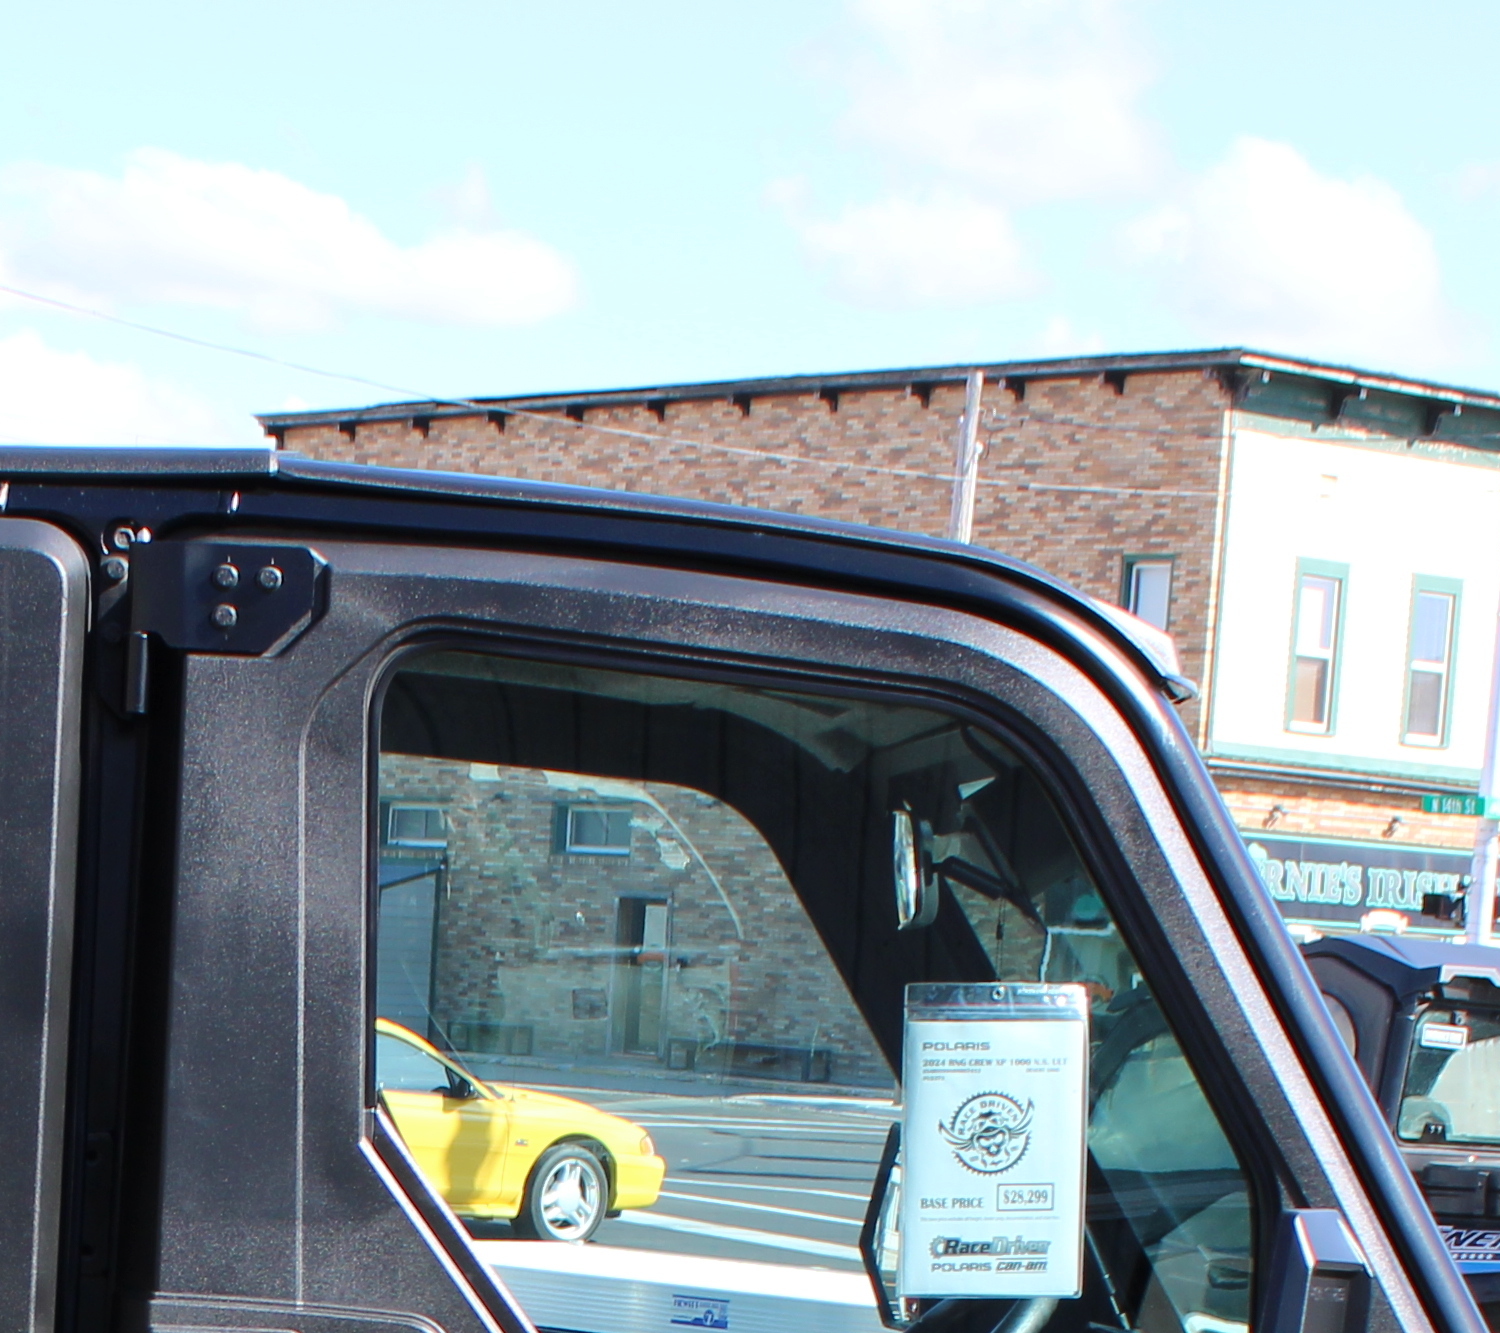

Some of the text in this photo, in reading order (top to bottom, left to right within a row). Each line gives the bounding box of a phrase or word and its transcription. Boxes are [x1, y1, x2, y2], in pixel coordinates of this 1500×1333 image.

[1431, 797, 1439, 812] N
[1442, 798, 1462, 813] 14th
[1465, 798, 1476, 814] St
[1260, 859, 1362, 906] RNIE'S
[922, 1041, 991, 1051] POLARIS
[922, 1058, 946, 1067] 2024
[958, 1100, 1020, 1136] RACE DRIVEN
[920, 1197, 985, 1209] BASE PRICE
[1003, 1190, 1049, 1205] $28,299
[931, 1262, 992, 1272] POLARIS
